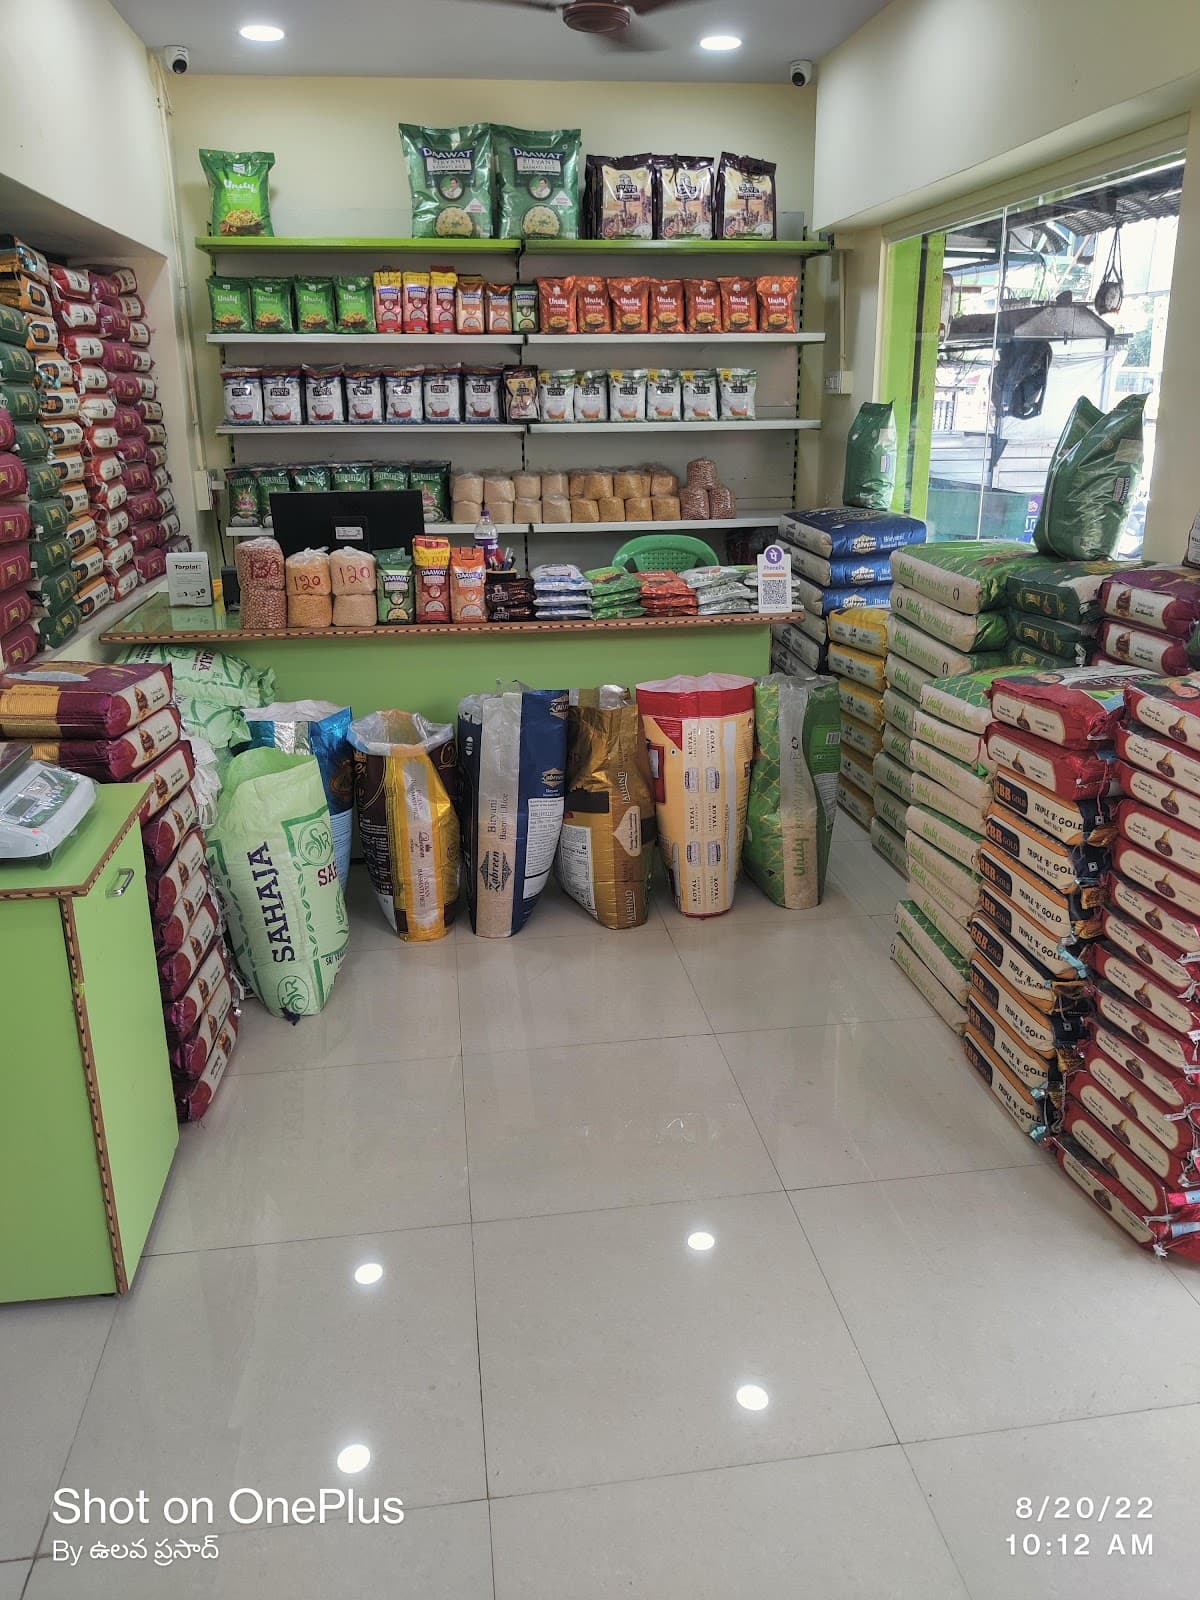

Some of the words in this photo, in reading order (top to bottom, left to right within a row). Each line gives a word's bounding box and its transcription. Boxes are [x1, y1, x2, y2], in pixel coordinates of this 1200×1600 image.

[423, 147, 473, 159] DAAWAT
[514, 148, 563, 160] DAAWAT
[548, 298, 568, 307] Unity
[584, 297, 604, 306] Unity
[621, 297, 641, 306] Unity
[657, 296, 676, 305] Unity
[730, 296, 750, 305] Unity
[768, 297, 788, 306] Unity
[338, 565, 371, 585] 120
[421, 568, 447, 576] DAAWAT
[294, 574, 320, 590] 120
[488, 799, 497, 833] Biryani
[1034, 803, 1050, 822] TRIPLE
[419, 831, 430, 858] Queen
[792, 838, 809, 877] Unity
[1027, 847, 1043, 866] TRIPLE
[489, 851, 499, 893] Zabreen
[247, 841, 296, 964] SAHAJA
[625, 890, 636, 924] JAIHIND
[1019, 887, 1034, 908] TRIPLE
[1041, 906, 1062, 923] GOLD
[970, 926, 988, 950] BBB
[1018, 925, 1033, 944] TRIPLE
[1008, 959, 1024, 979] TRIPLE
[1004, 1003, 1019, 1023] TRIPLE
[1001, 1041, 1016, 1061] TRIPLE
[1023, 1063, 1048, 1079] GOLD
[998, 1083, 1013, 1104] TRIPLE
[1019, 1106, 1041, 1123] GOLD
